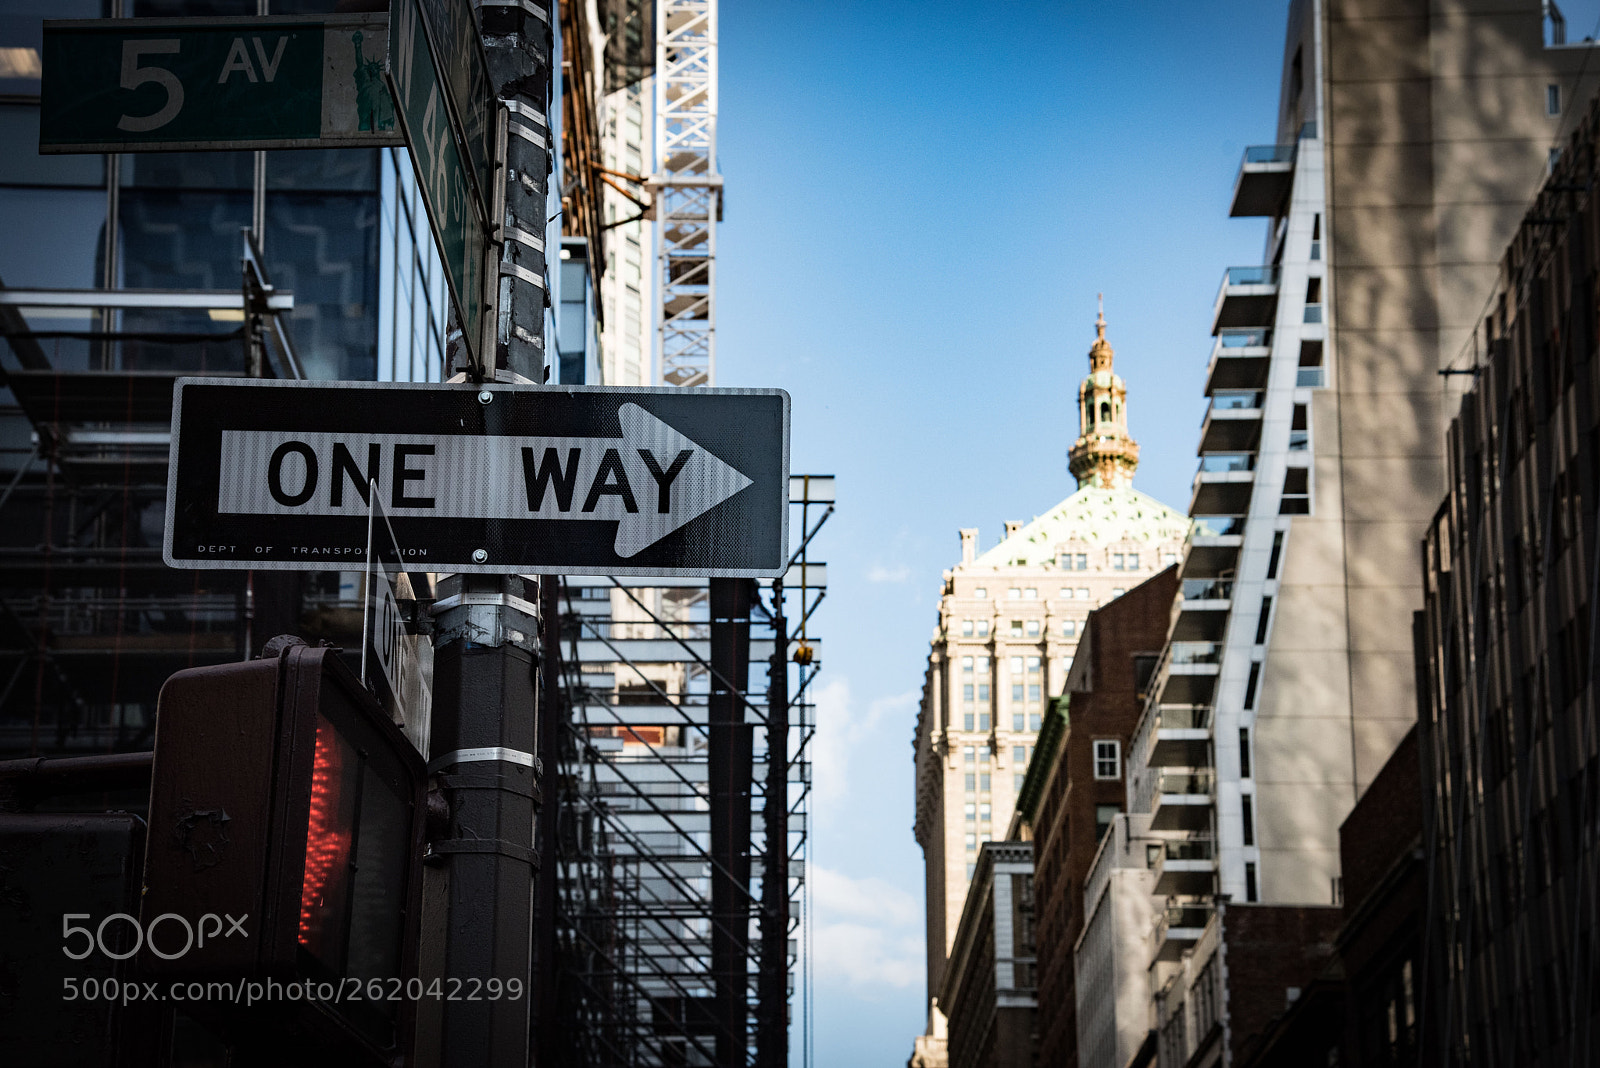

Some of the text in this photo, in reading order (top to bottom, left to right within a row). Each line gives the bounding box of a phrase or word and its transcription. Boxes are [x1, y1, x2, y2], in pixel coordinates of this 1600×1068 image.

[117, 36, 289, 132] 5 AV
[398, 0, 469, 241] W 46 ST
[442, 0, 490, 167] RAZIL
[267, 439, 694, 514] ONE WAY
[197, 544, 428, 556] DEPT OF TRANSPOION
[382, 591, 410, 712] ONE
